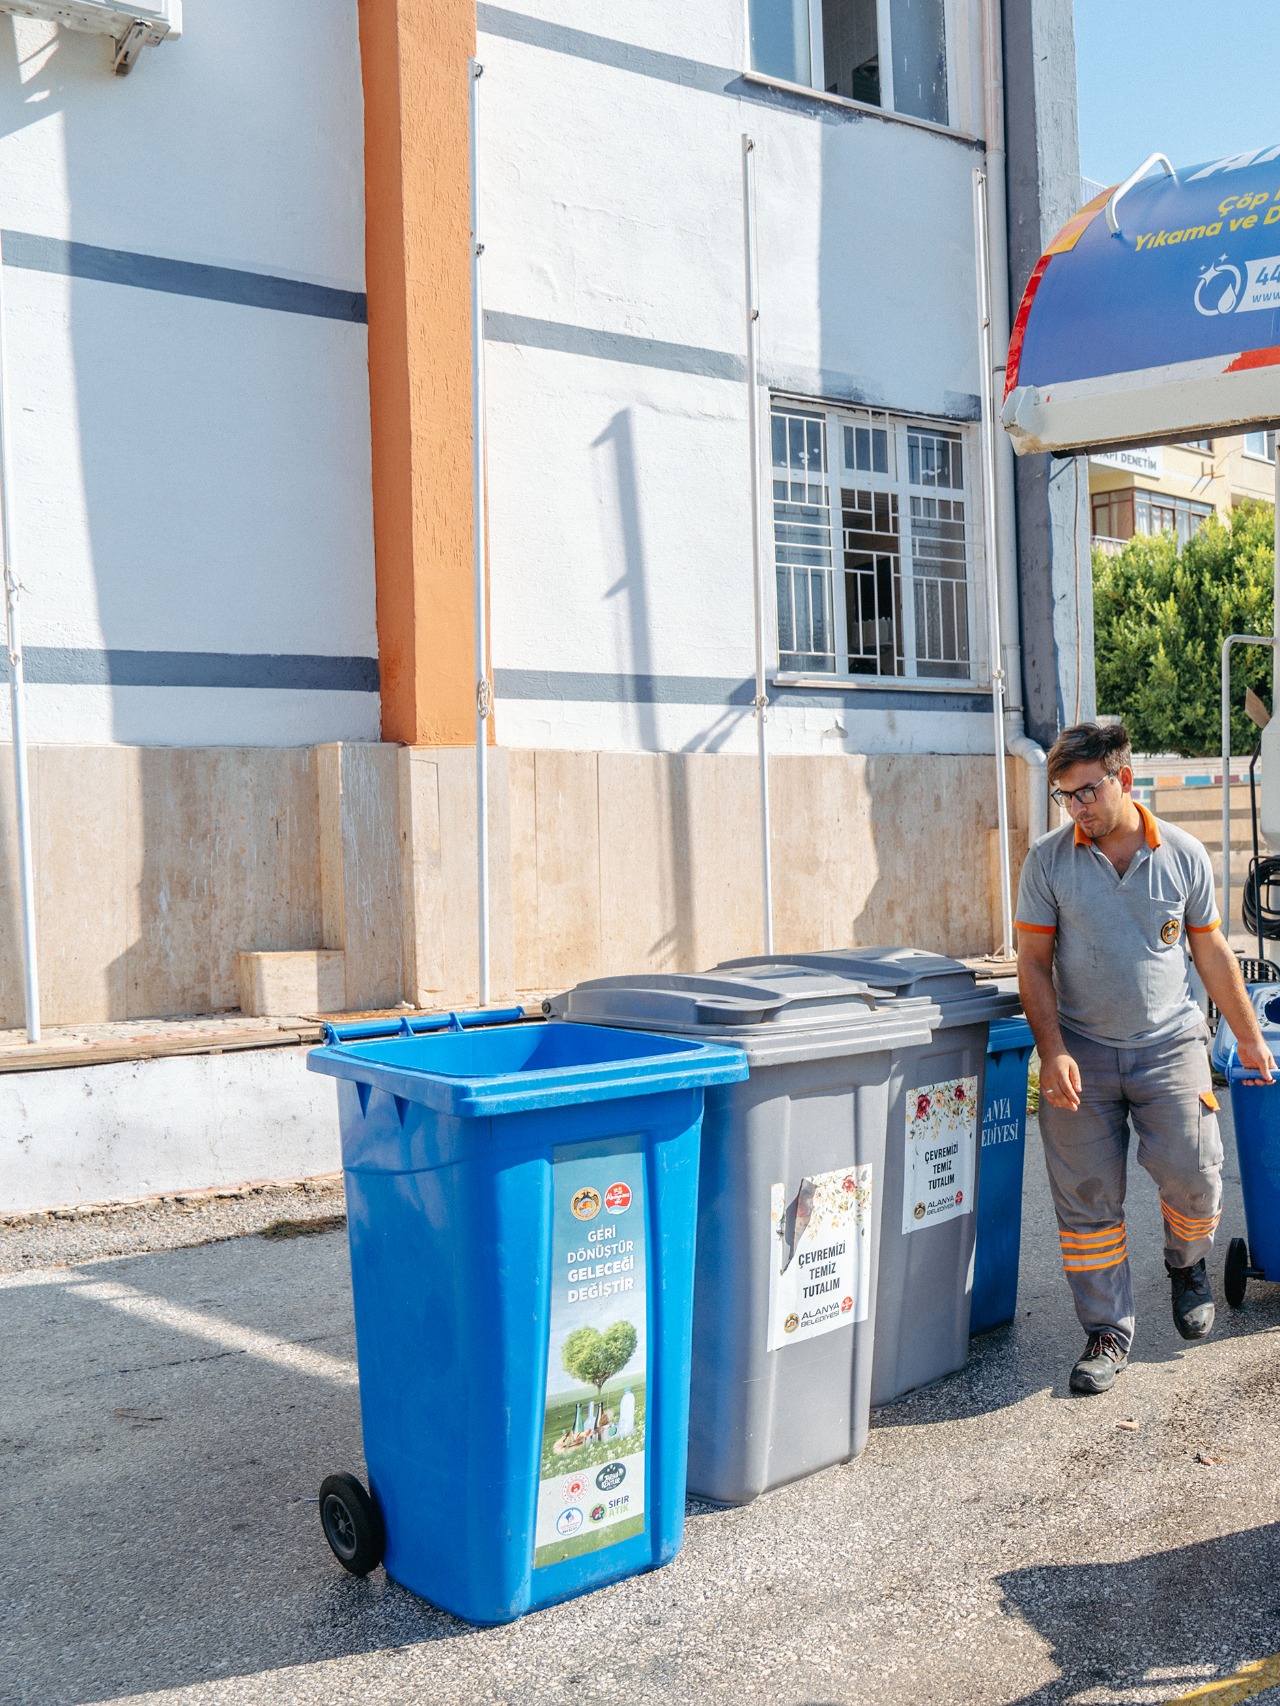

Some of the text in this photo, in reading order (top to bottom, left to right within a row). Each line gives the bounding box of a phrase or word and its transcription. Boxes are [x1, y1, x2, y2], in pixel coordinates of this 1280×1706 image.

[1218, 191, 1269, 217] Çöp
[1135, 222, 1223, 251] Yıkama
[1229, 214, 1258, 231] ve
[1121, 453, 1157, 470] DENETİM
[983, 1098, 1011, 1123] ANYA
[924, 1141, 959, 1164] ÇEVREMİZİ
[932, 1159, 952, 1175] TEMİZ
[928, 1173, 955, 1191] TUTALIM
[927, 1194, 954, 1209] ALANYA
[587, 1224, 616, 1243] GERİ
[567, 1240, 634, 1264] DÖNÜŞTÜR
[798, 1240, 846, 1269] ÇEVREMİZİ
[568, 1255, 634, 1283] GELECEĞİ
[809, 1261, 836, 1281] TEMİZ
[567, 1277, 634, 1303] DEĞİŞTİR
[803, 1277, 841, 1299] TUTALIM
[800, 1310, 840, 1328] BELEDİYESİ
[801, 1301, 840, 1320] ALANYA
[608, 1495, 630, 1509] SIFIR
[608, 1503, 629, 1518] ATIK
